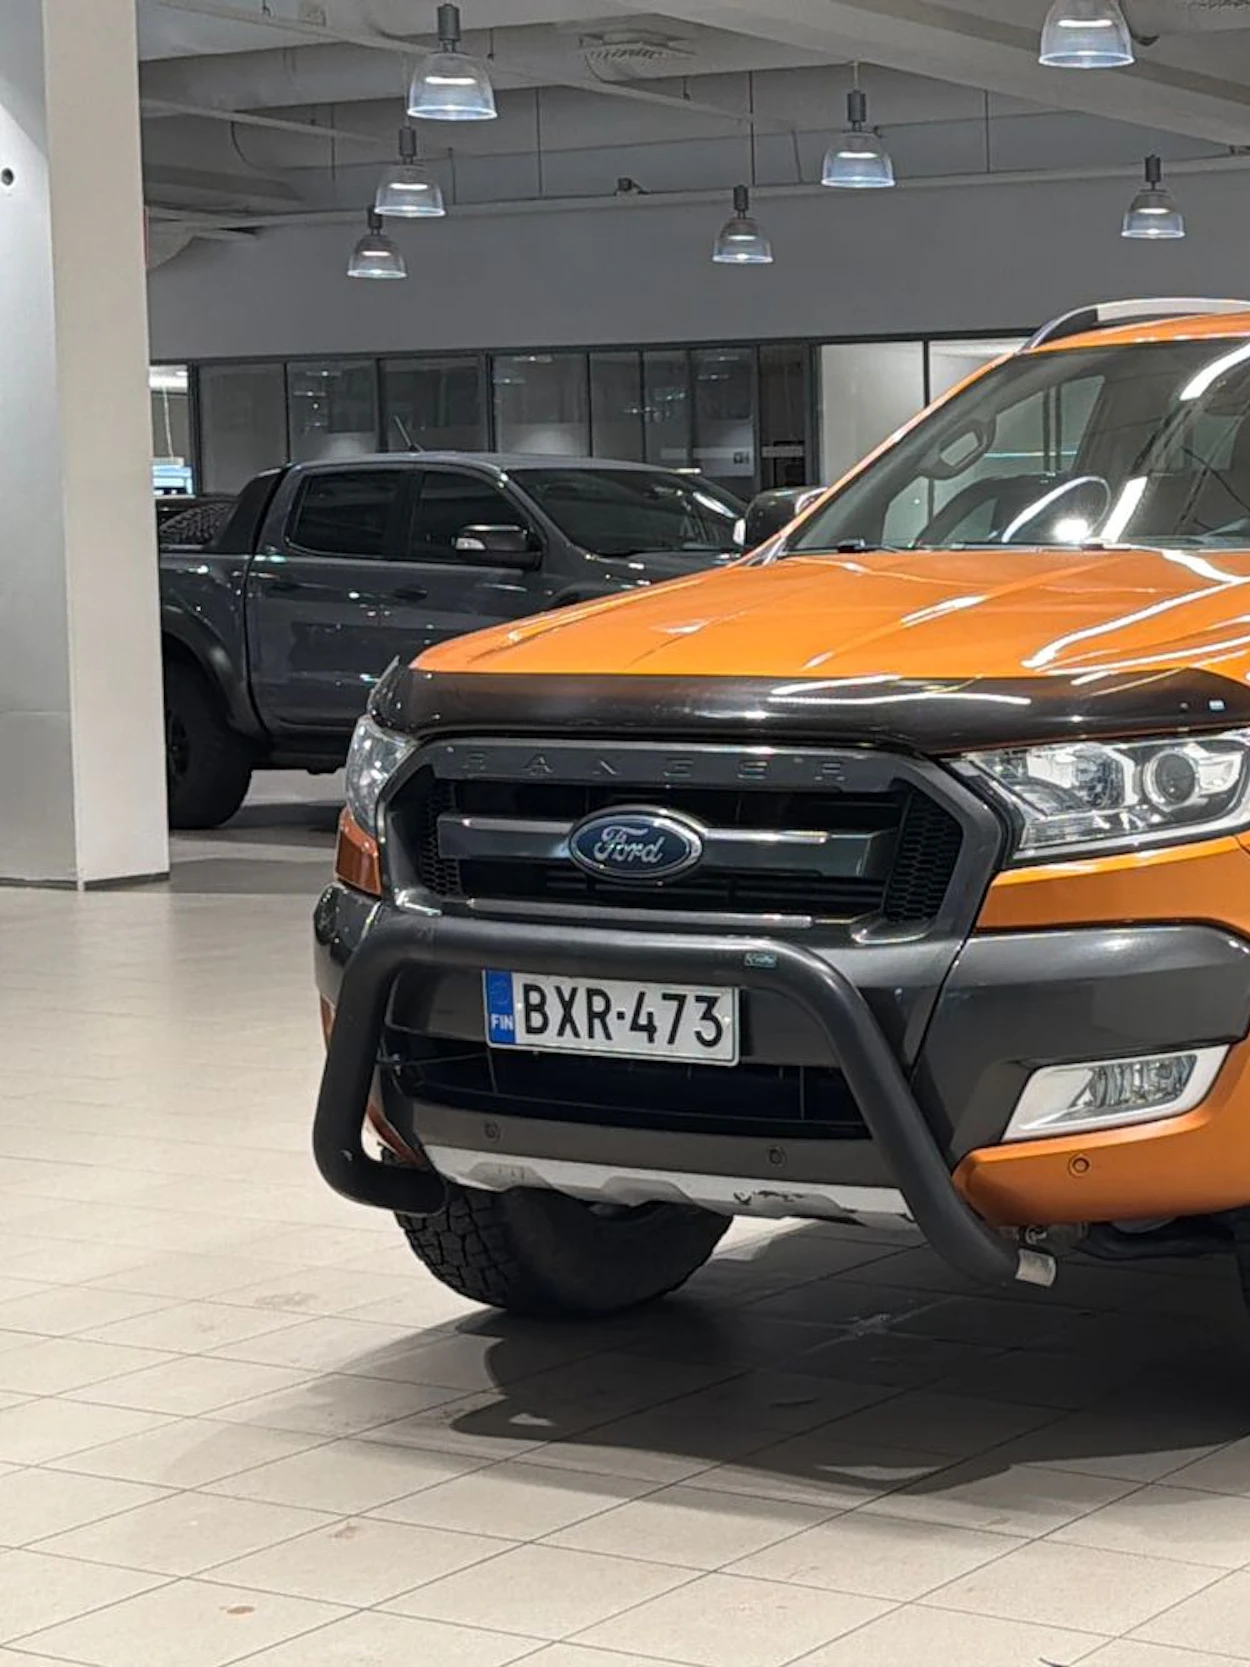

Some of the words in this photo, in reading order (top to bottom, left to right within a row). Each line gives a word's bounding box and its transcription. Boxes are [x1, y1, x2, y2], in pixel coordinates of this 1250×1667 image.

[594, 825, 666, 863] Ford
[490, 1013, 514, 1031] FIN
[522, 983, 723, 1048] BXR-473
